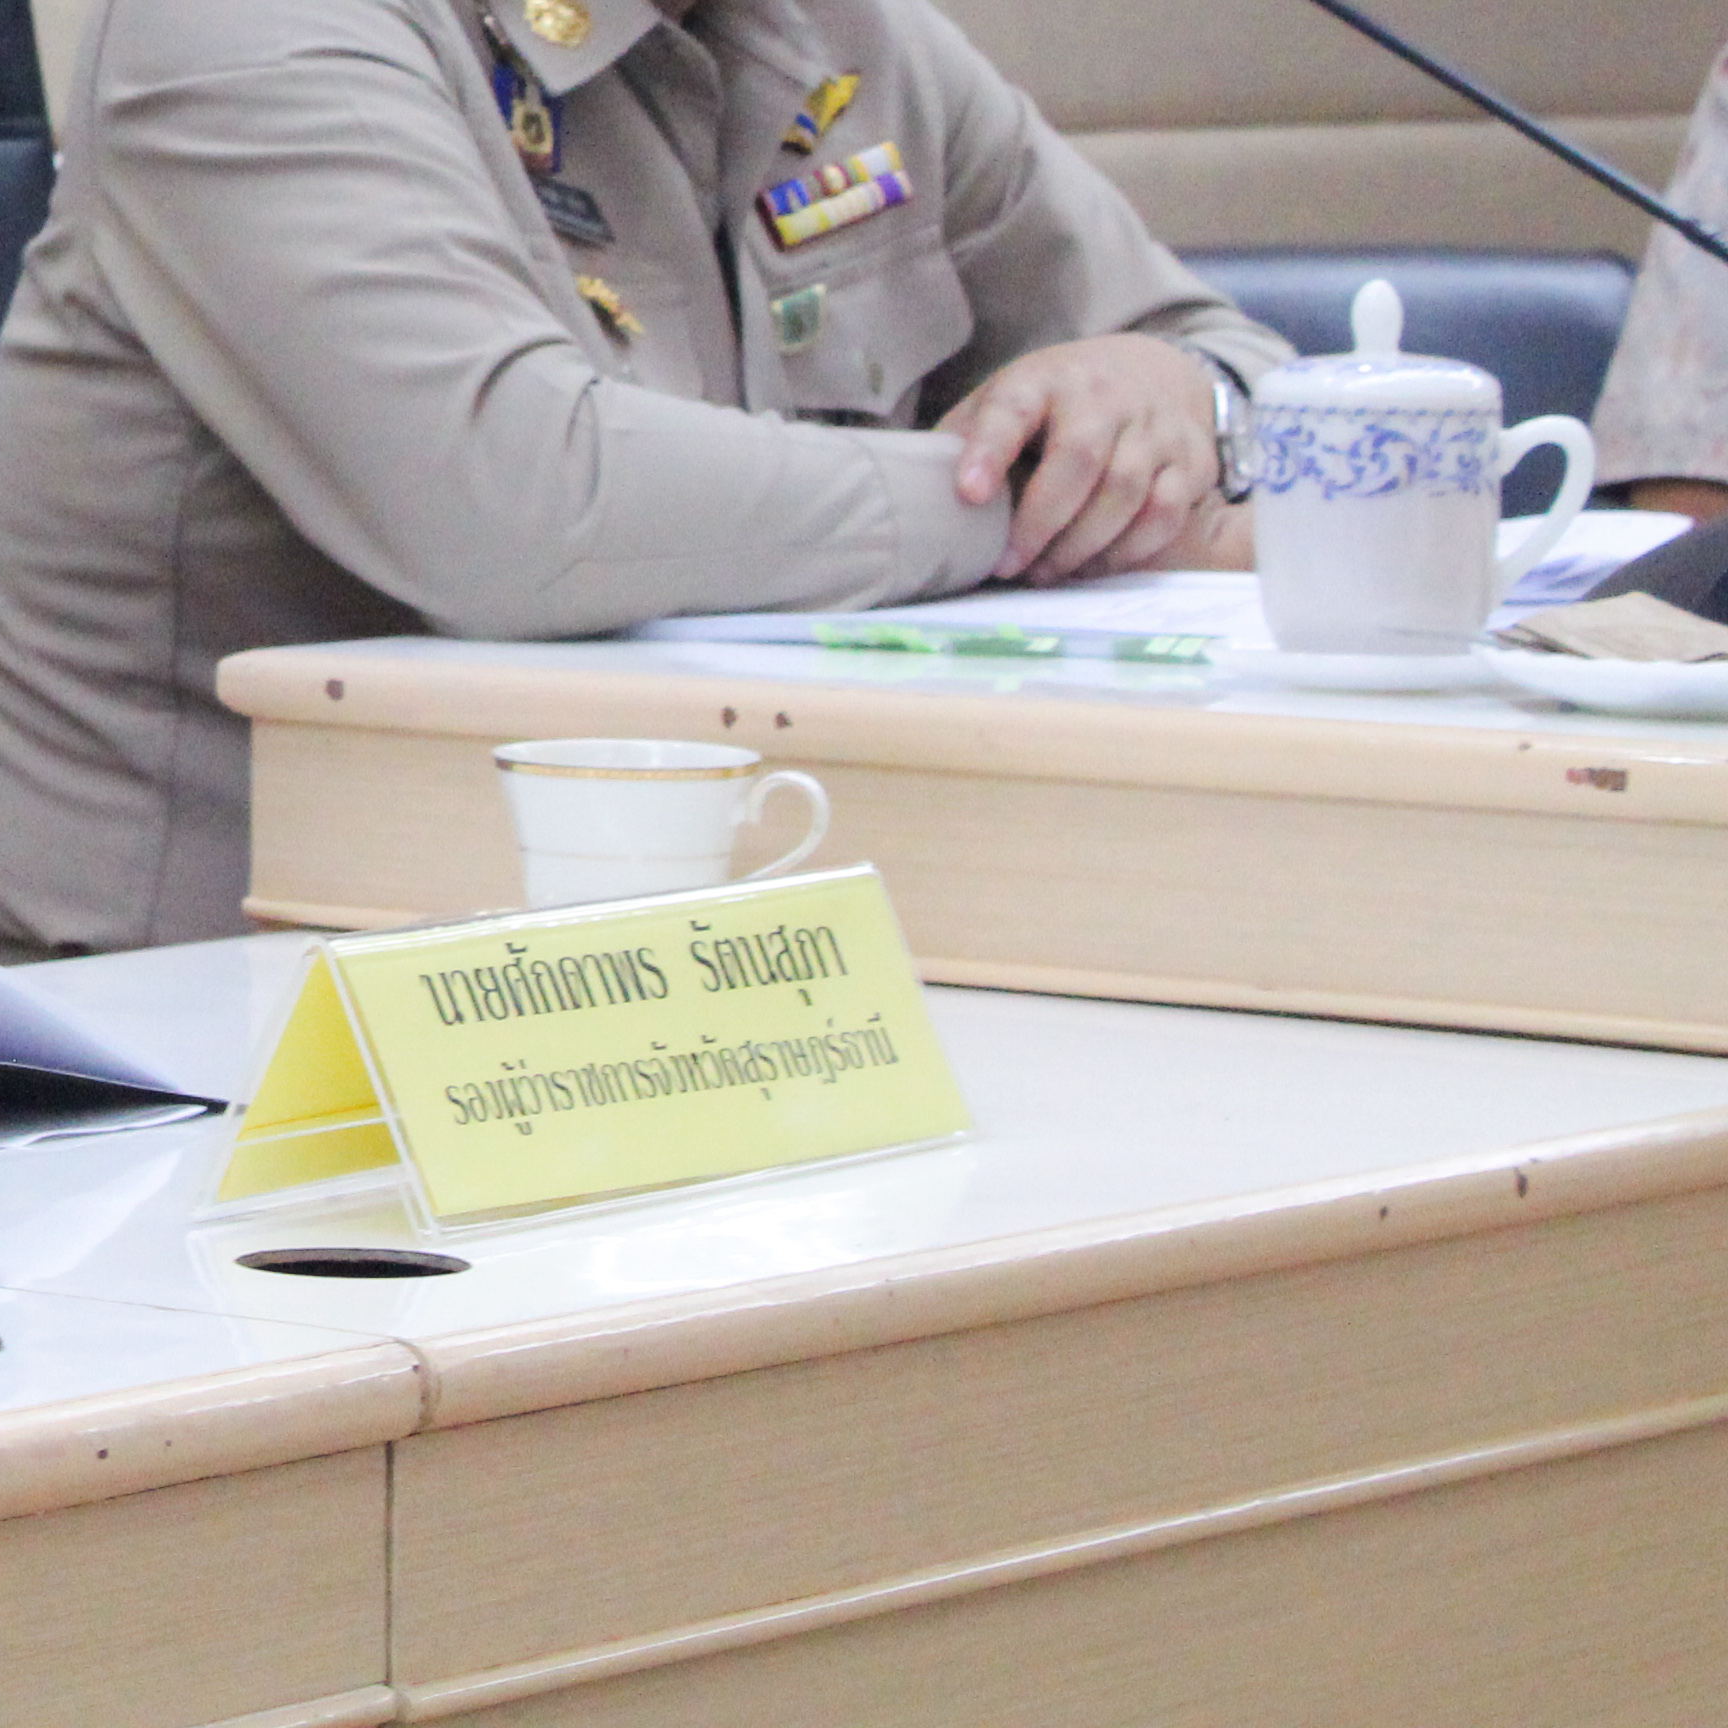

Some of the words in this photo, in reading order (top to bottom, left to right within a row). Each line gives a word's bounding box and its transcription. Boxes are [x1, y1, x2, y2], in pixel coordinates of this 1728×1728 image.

[419, 942, 669, 1026] นายศักดาพร
[688, 920, 849, 1007] รัตนสุภา
